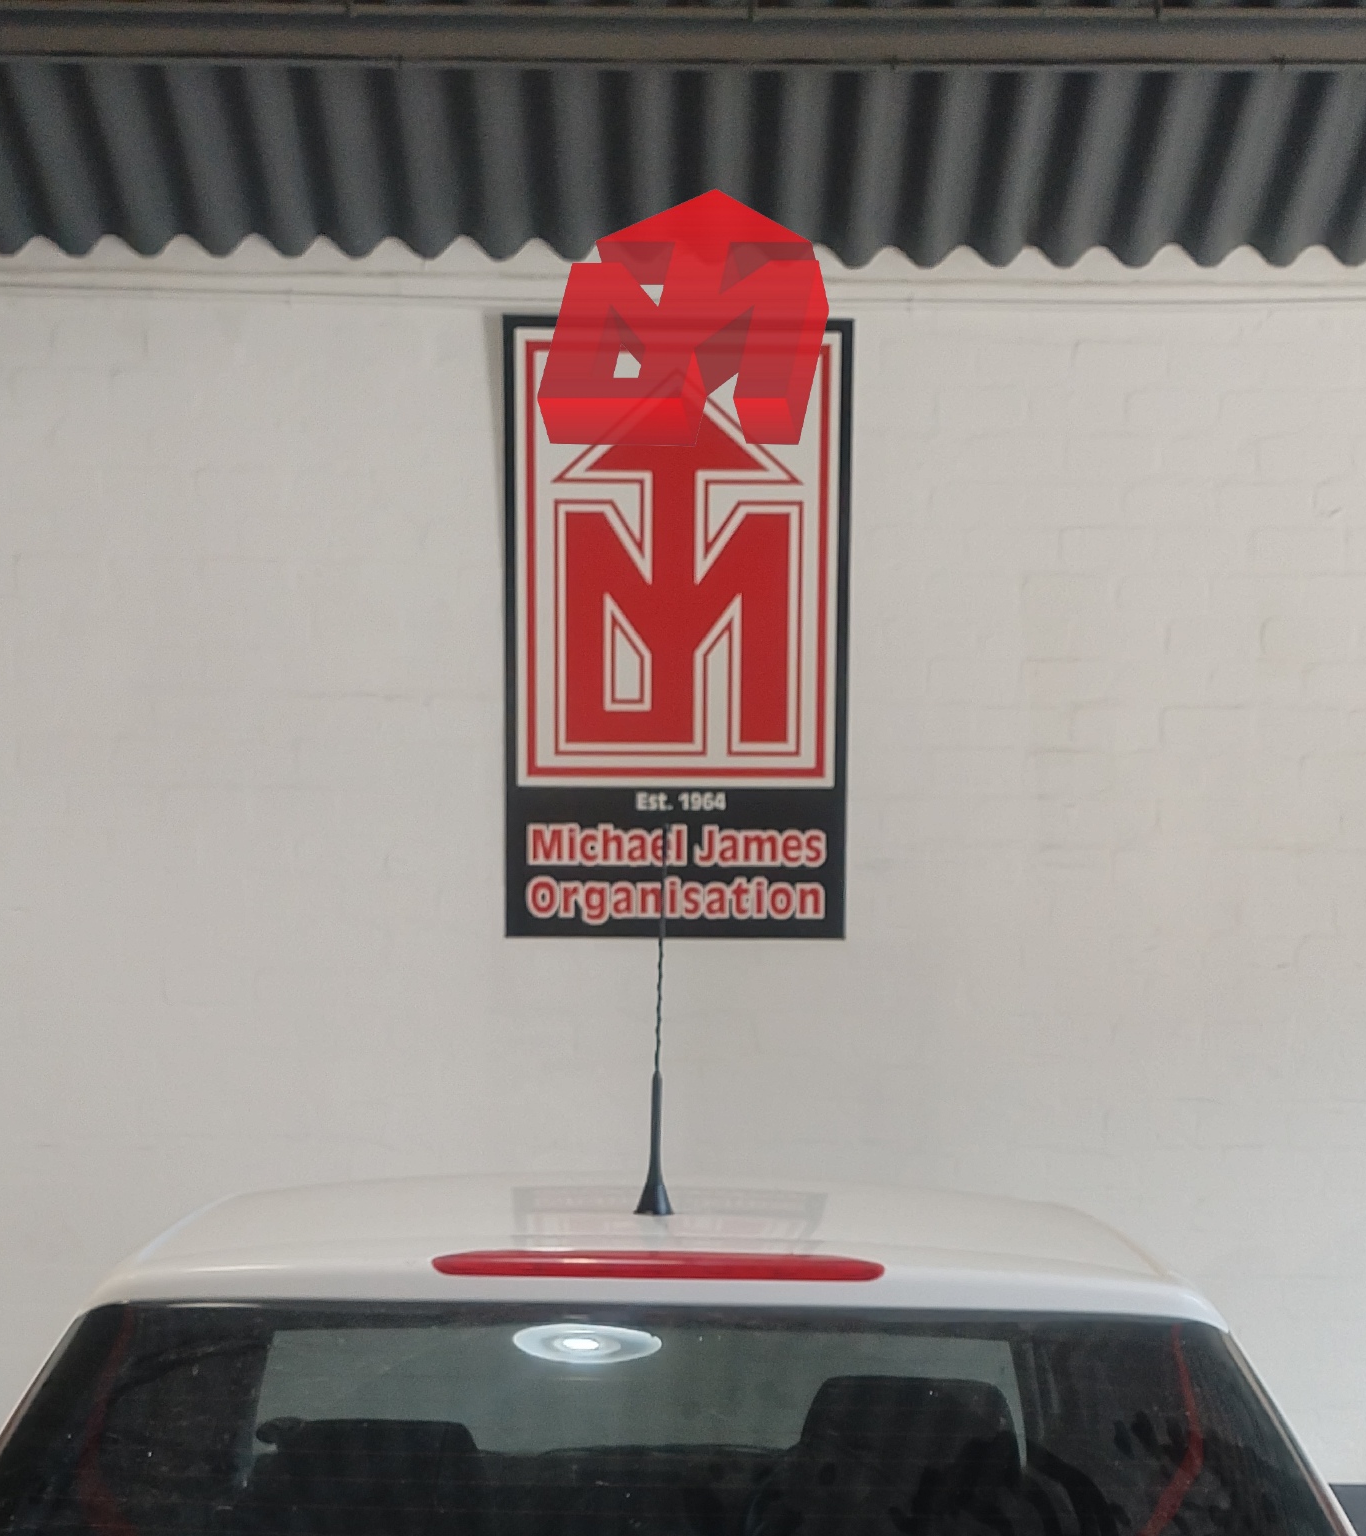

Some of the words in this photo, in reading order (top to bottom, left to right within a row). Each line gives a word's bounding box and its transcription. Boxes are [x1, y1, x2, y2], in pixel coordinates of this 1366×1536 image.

[635, 791, 674, 812] Est.
[677, 791, 727, 812] 1964
[527, 823, 688, 867] Michael
[694, 823, 827, 868] James
[527, 876, 825, 924] Organisation
